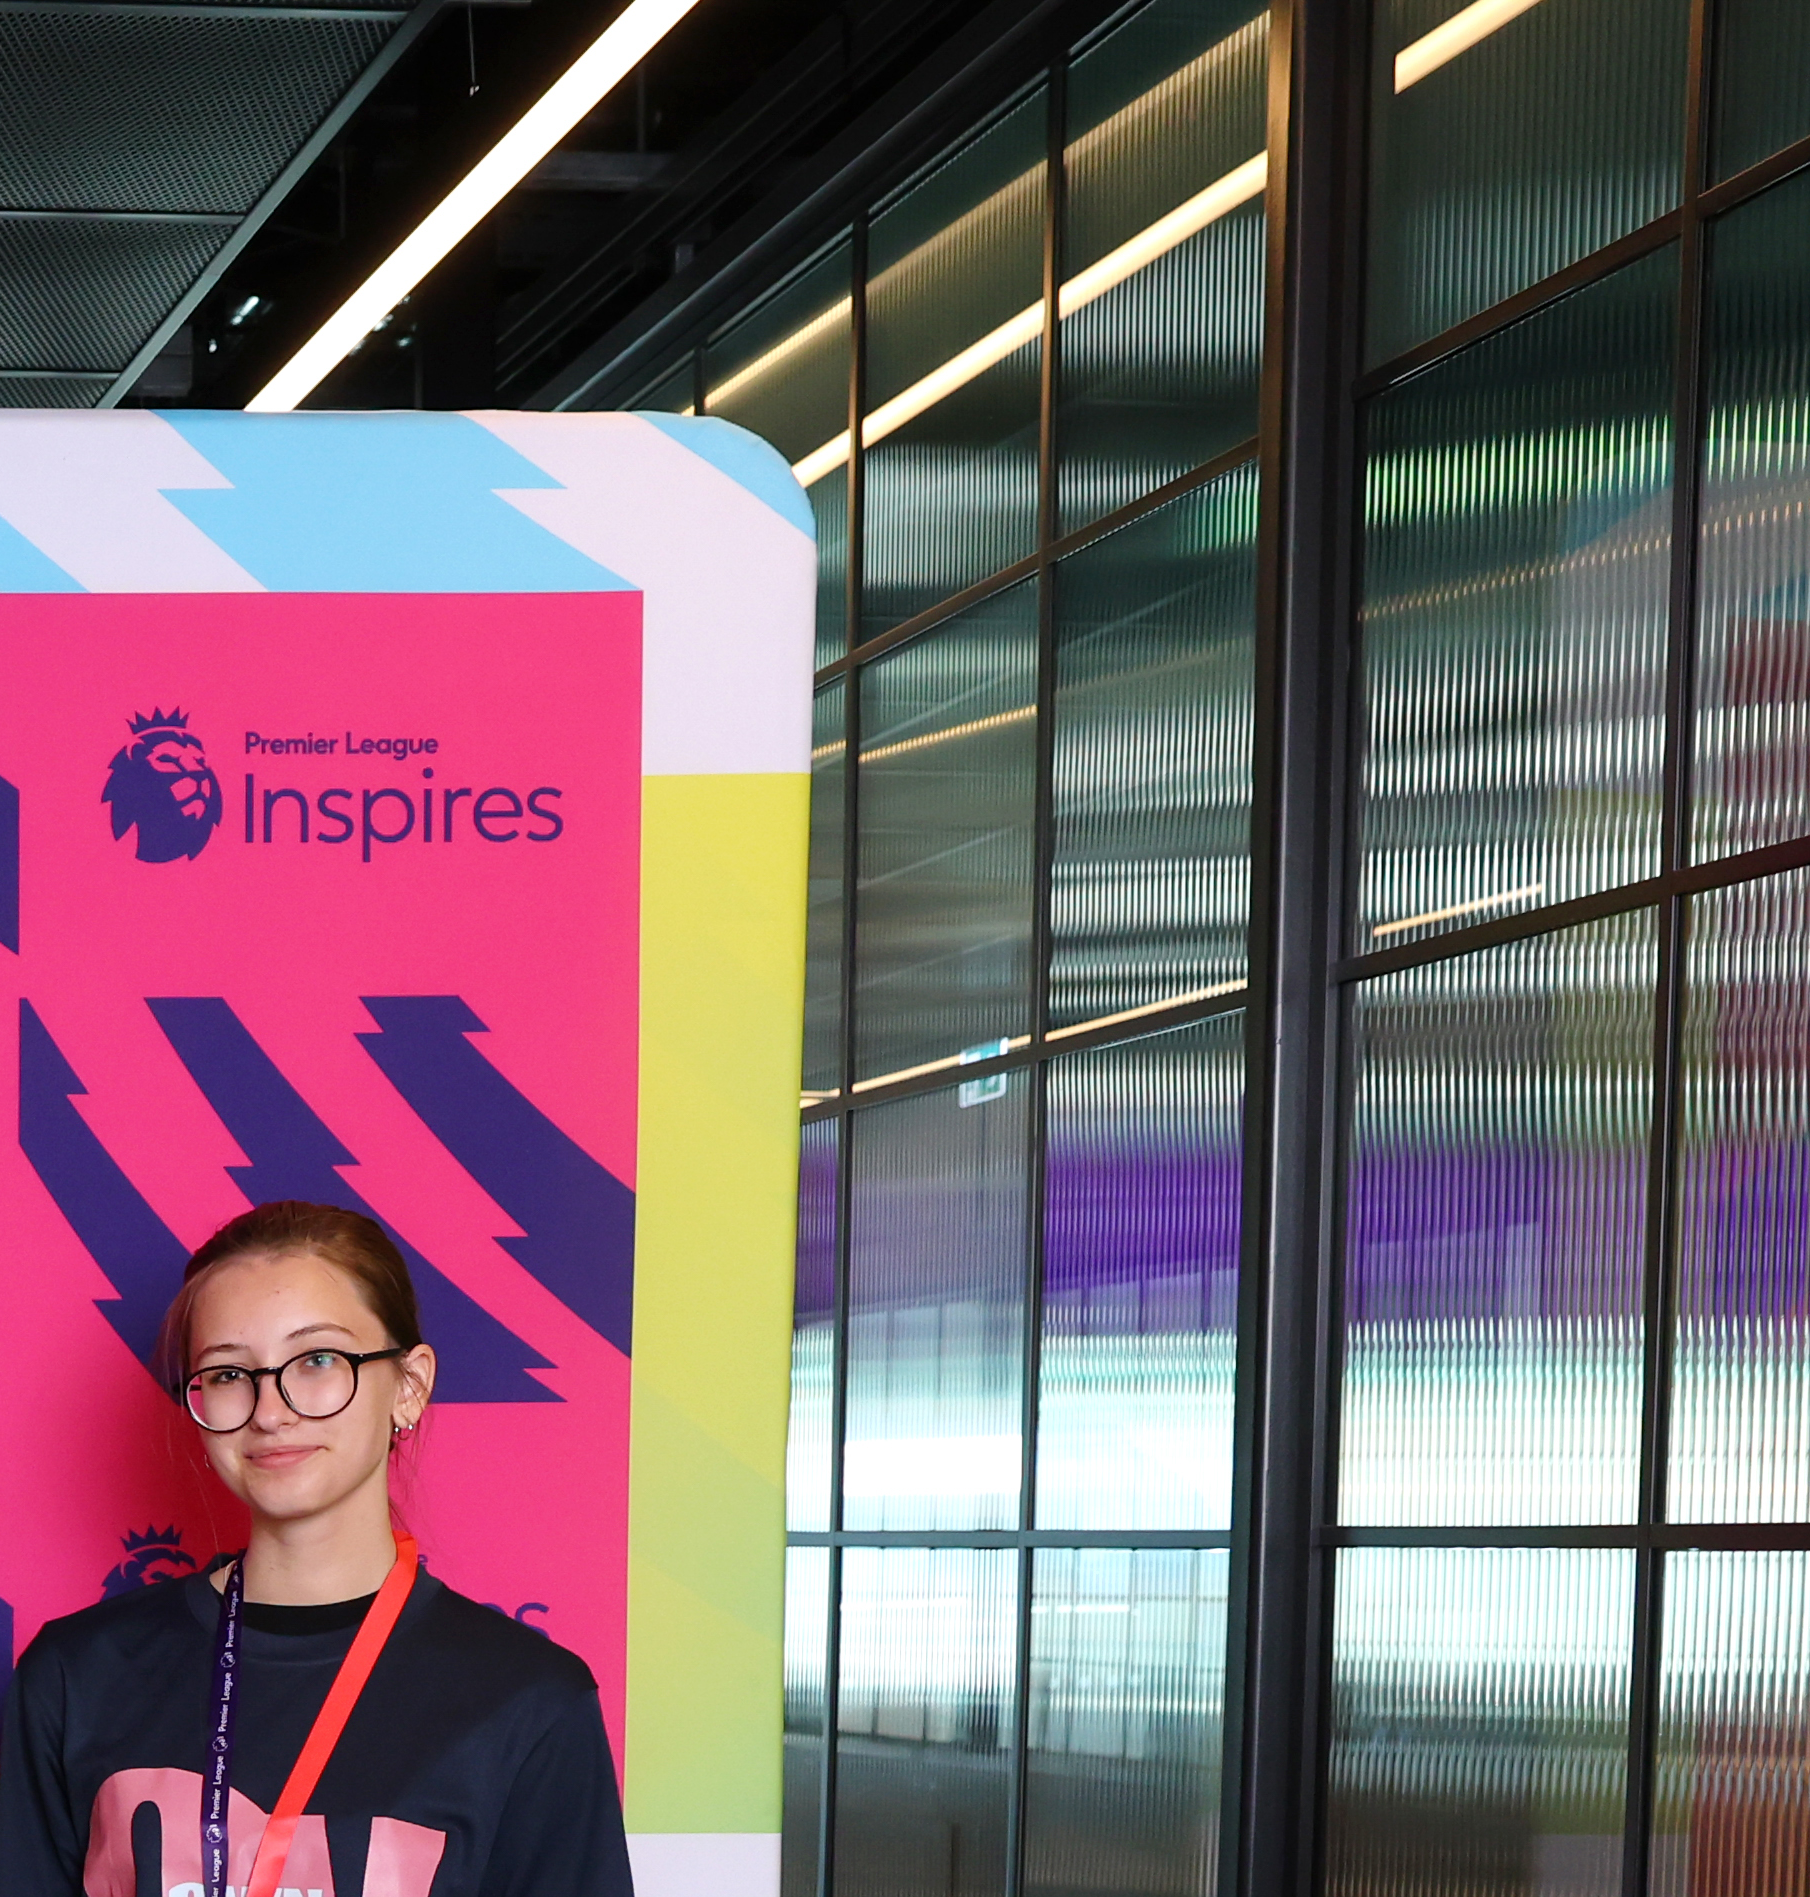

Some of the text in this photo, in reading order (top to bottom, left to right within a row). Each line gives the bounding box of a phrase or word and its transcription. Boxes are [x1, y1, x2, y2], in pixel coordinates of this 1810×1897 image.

[245, 731, 438, 761] Premier League
[244, 768, 565, 862] Inspires
[210, 1755, 225, 1820] Premier League
[212, 1848, 223, 1883] League
